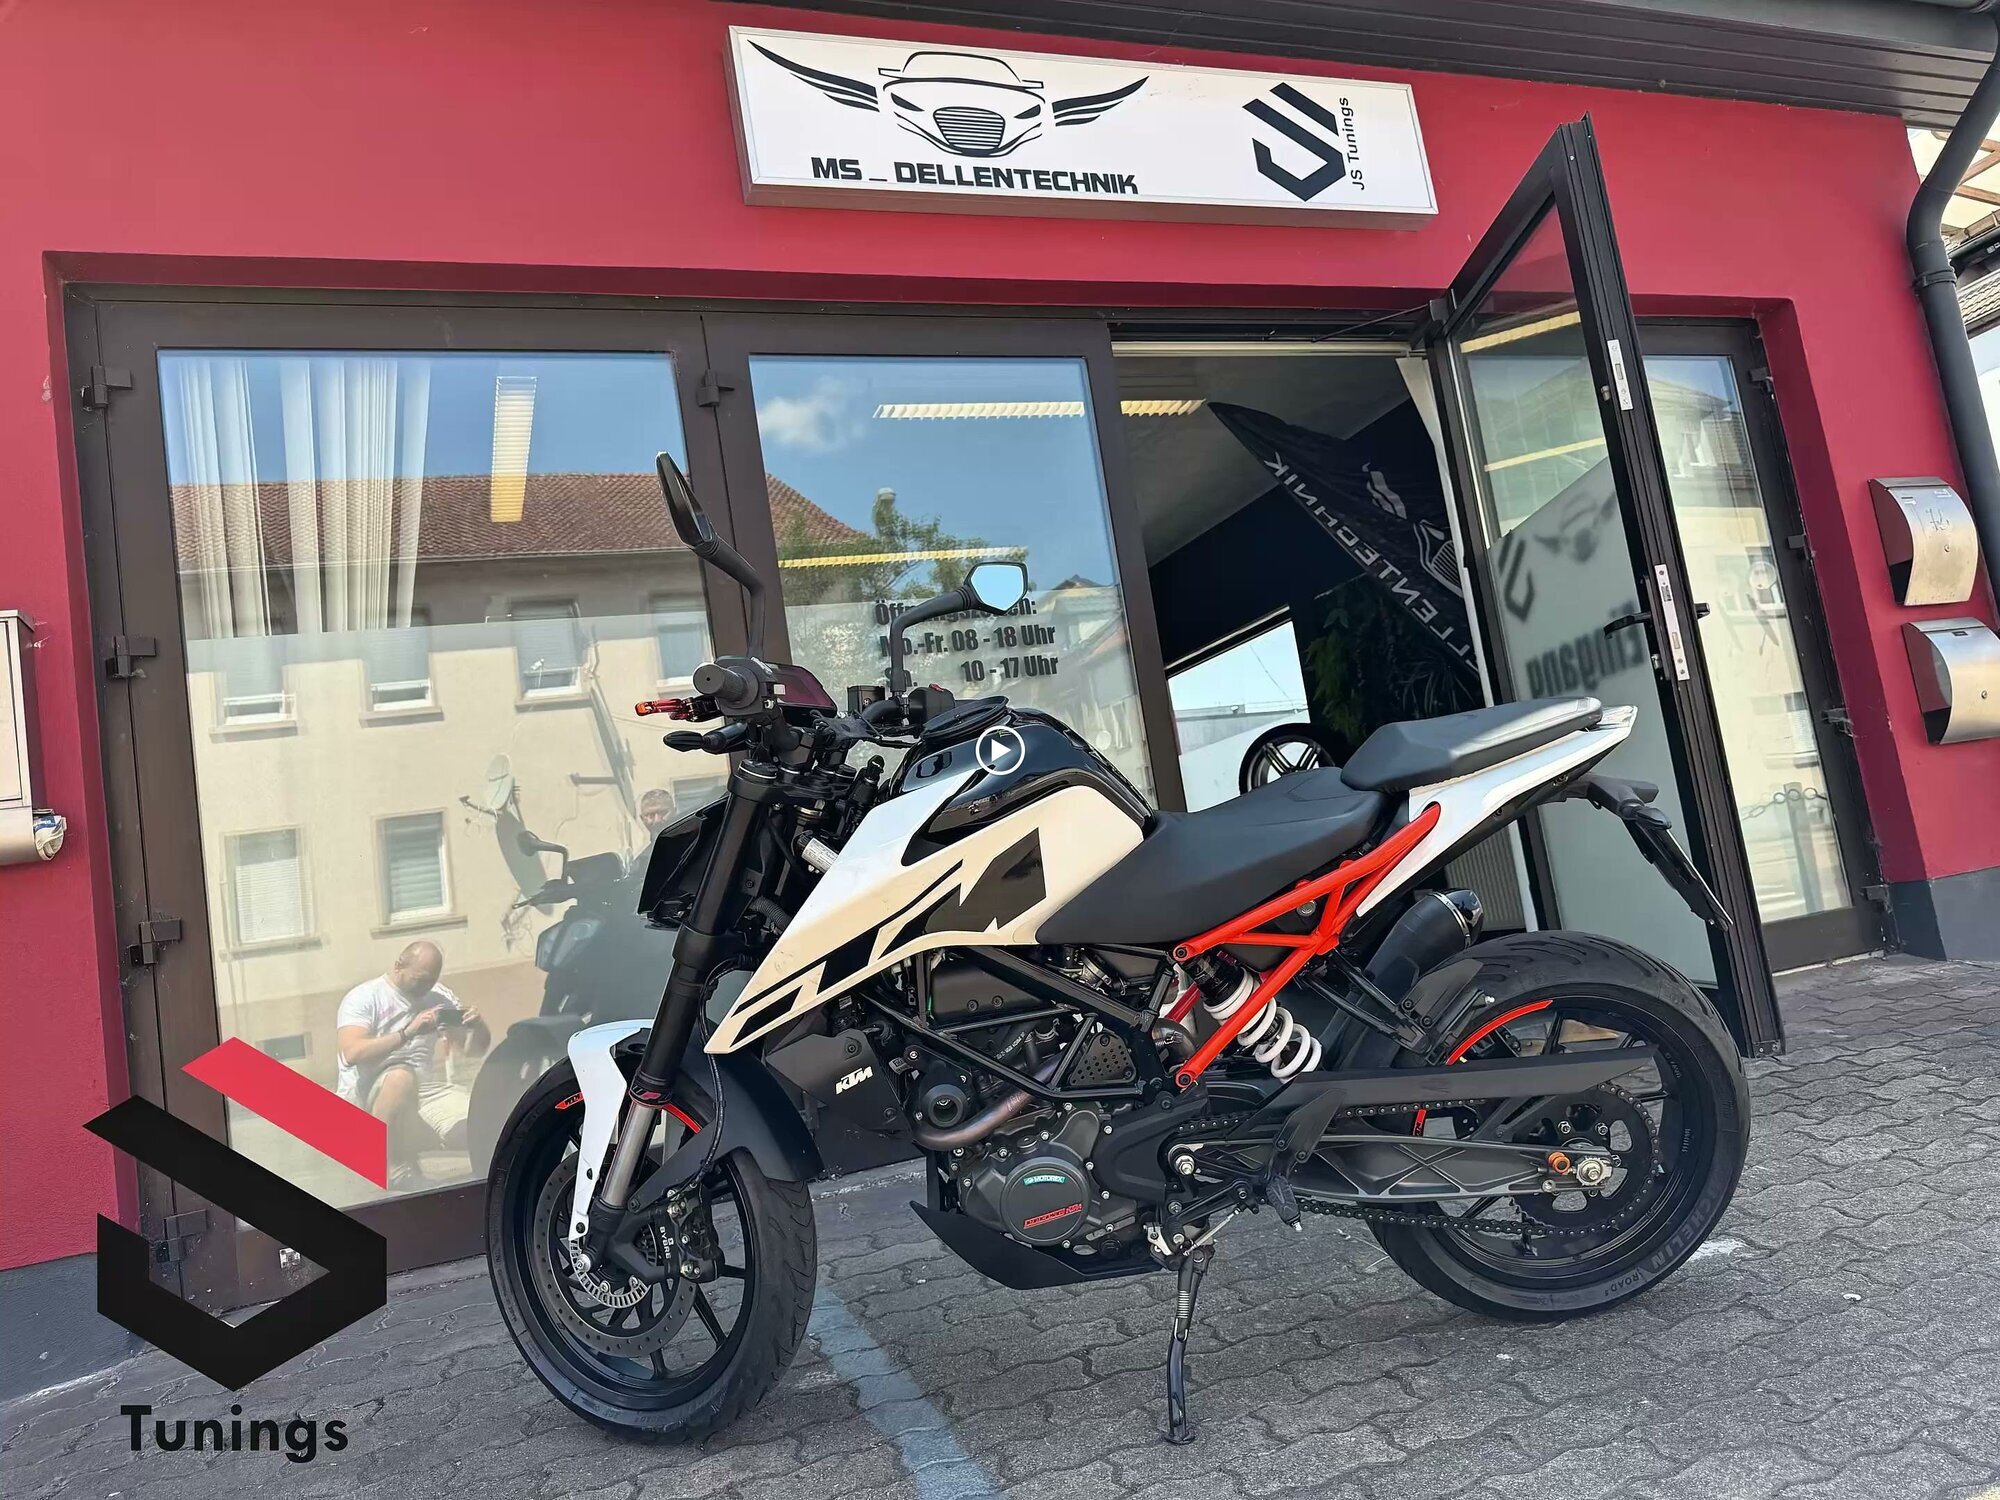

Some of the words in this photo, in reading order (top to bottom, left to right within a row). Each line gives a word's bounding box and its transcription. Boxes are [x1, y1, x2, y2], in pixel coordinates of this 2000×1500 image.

[1339, 97, 1360, 163] Tunings
[810, 156, 863, 181] MS
[893, 161, 1139, 195] DELLENTECHNIK
[1350, 169, 1364, 190] JS
[951, 628, 979, 652] 08
[993, 626, 1018, 648] 18
[1020, 624, 1056, 646] Uhr
[960, 659, 986, 682] 10
[1000, 657, 1020, 679] 17
[1023, 655, 1059, 677] Uhr
[835, 1066, 873, 1095] KTM
[1610, 1272, 1640, 1293] ROAD
